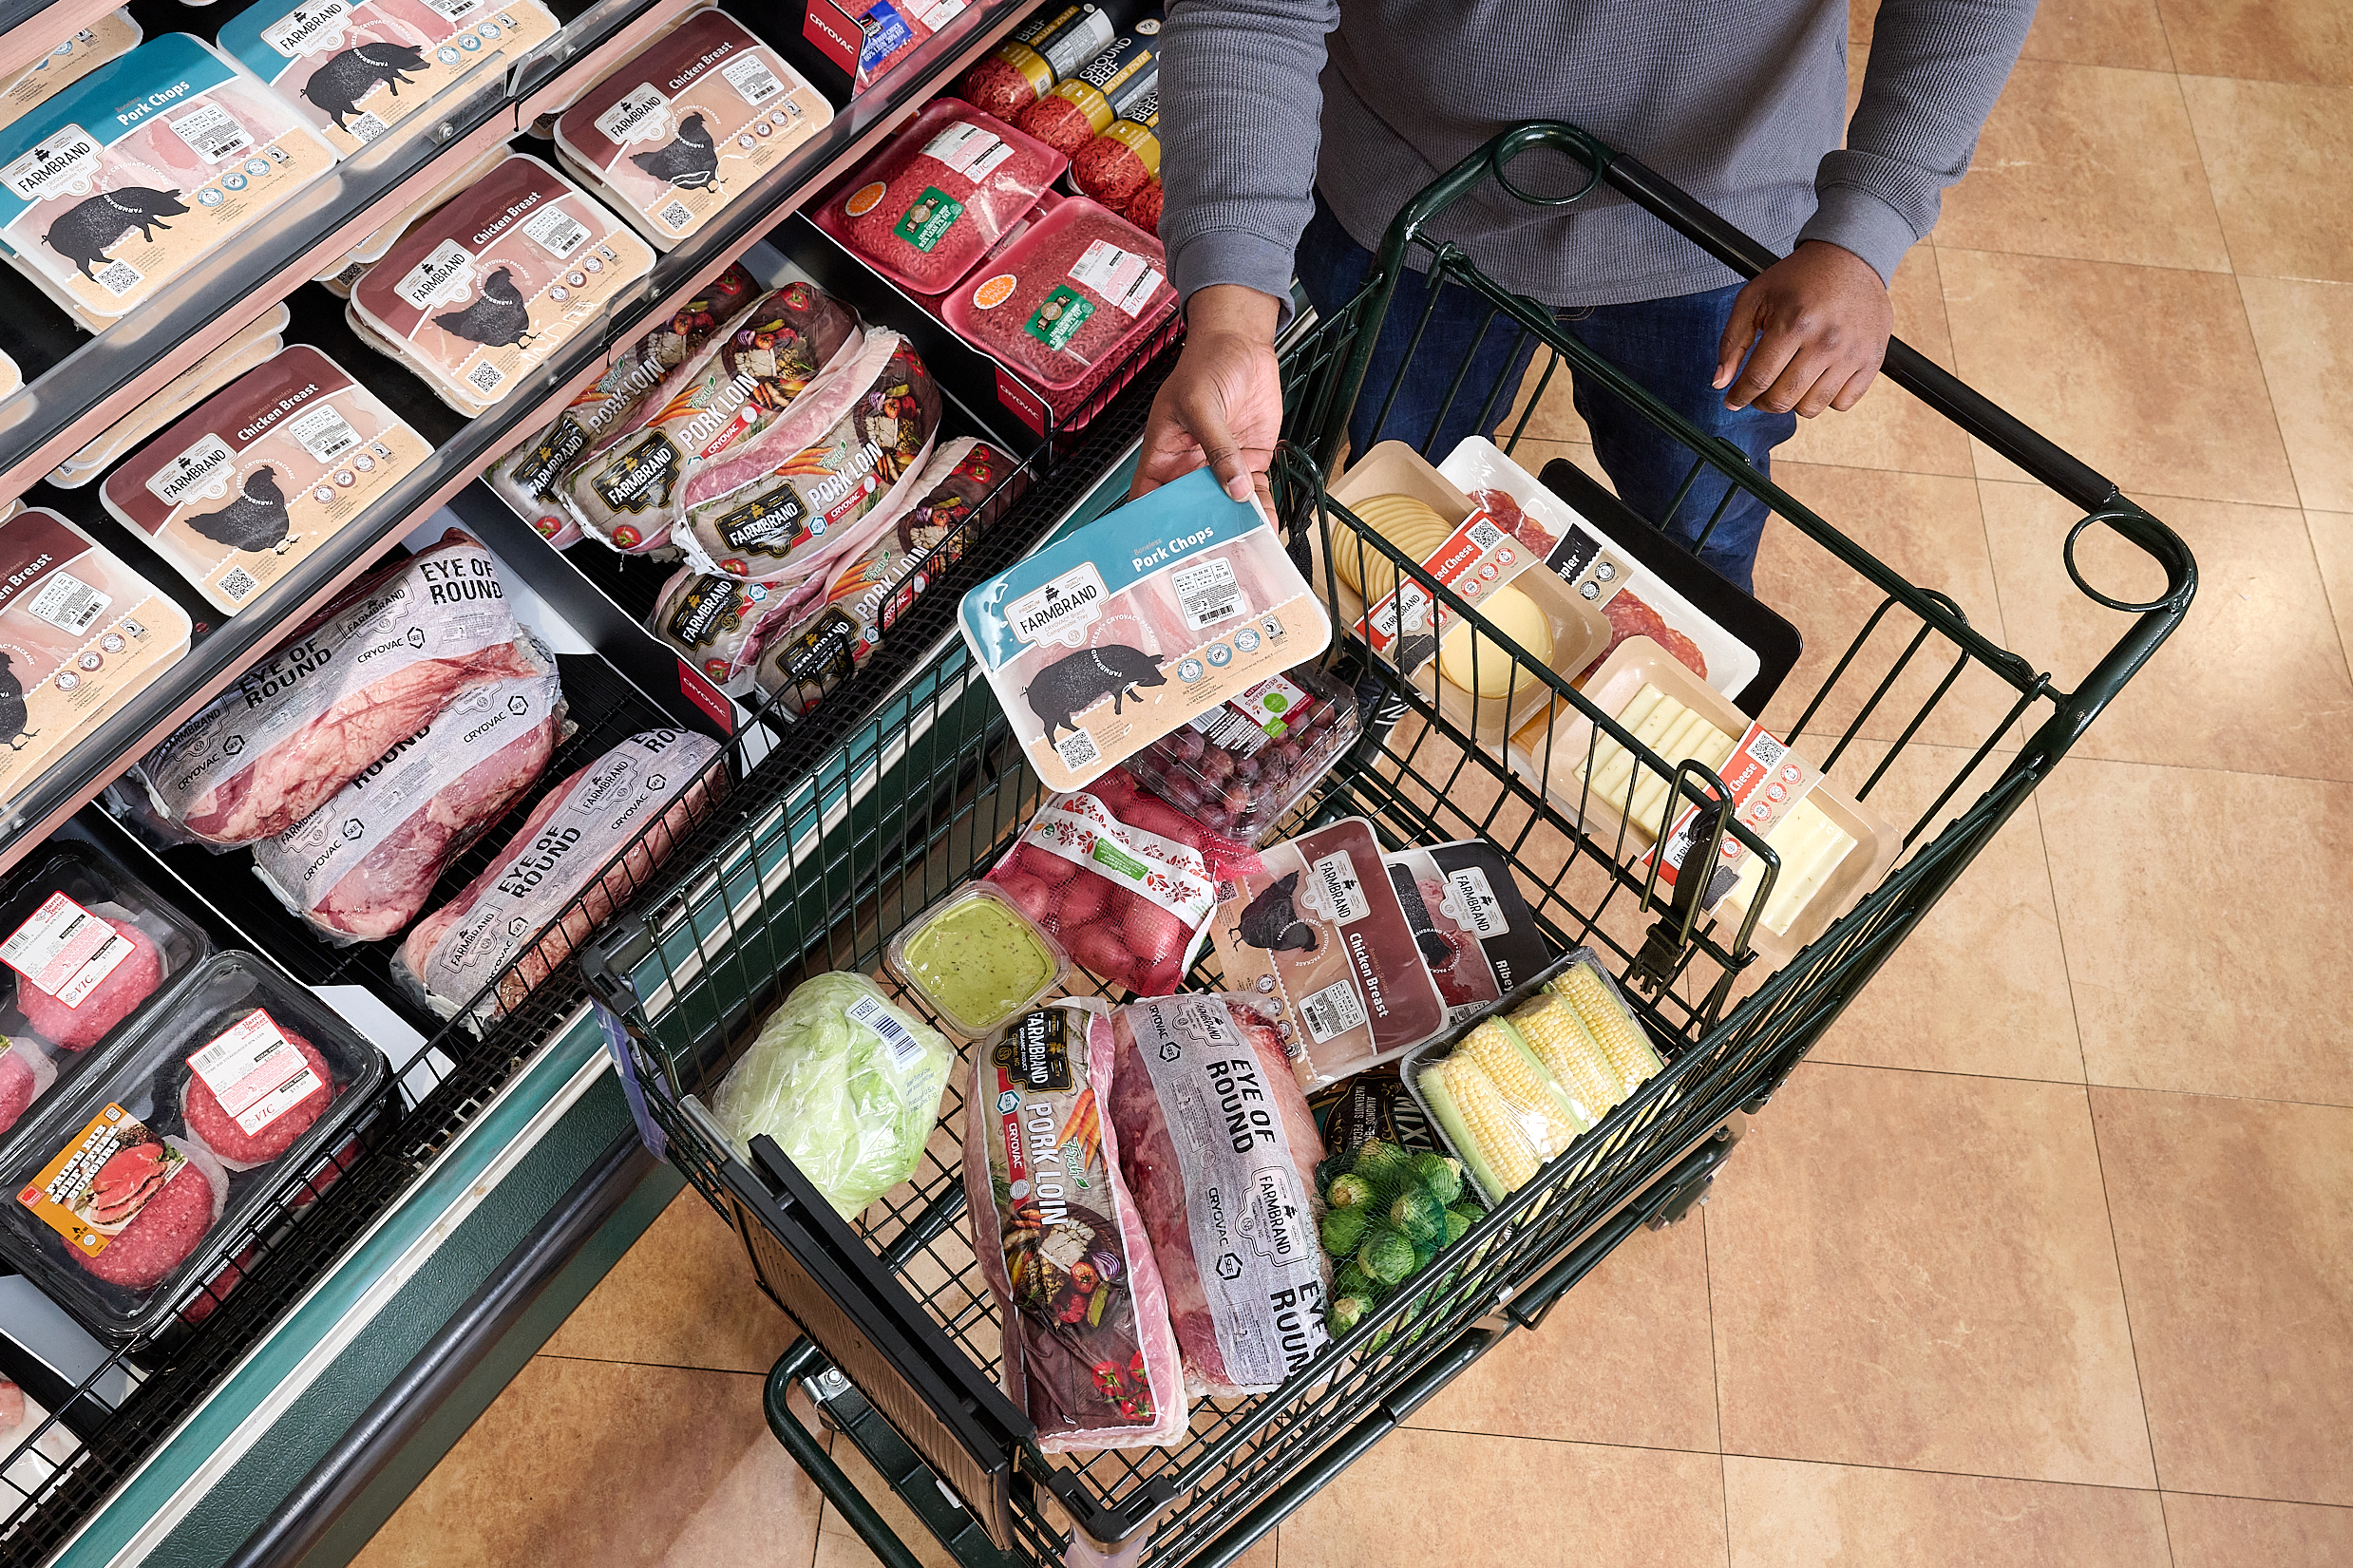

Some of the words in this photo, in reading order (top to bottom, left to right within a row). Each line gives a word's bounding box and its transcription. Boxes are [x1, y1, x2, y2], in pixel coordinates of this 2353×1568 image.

[279, 3, 342, 50] FARMBRAND
[809, 12, 854, 55] CRYOVAC
[876, 31, 891, 44] BEEF
[886, 22, 901, 36] CHUCK
[896, 28, 905, 38] FAT
[1015, 19, 1046, 42] BEEF
[1042, 25, 1055, 39] LEAN
[1066, 7, 1076, 18] FAT
[669, 60, 706, 90] Chicken
[702, 41, 733, 66] Breast
[1079, 37, 1132, 80] GROUND
[1091, 62, 1120, 87] BEEF
[1104, 80, 1116, 92] 73%
[1113, 69, 1129, 84] LEAN
[1128, 60, 1142, 72] 27%
[1139, 51, 1150, 63] FAT
[116, 102, 152, 126] Pork
[148, 80, 191, 106] Chops
[611, 96, 661, 137] FARMBRAND
[12, 161, 33, 177] PREMIUM
[53, 136, 72, 149] QUALITY
[17, 142, 90, 193] FARMBRAND
[852, 187, 876, 208] VALUE
[860, 192, 879, 209] PACK
[472, 212, 512, 245] Chicken
[508, 191, 541, 218] Breast
[919, 236, 930, 248] 93%
[927, 224, 939, 239] LEAN
[937, 217, 945, 229] 7%
[943, 210, 952, 220] FAT
[412, 254, 465, 302] FARMBRAND
[980, 279, 1005, 299] VALUE
[989, 284, 1009, 302] PACK
[1049, 333, 1061, 346] 93%
[1059, 323, 1072, 338] LEAN
[1074, 308, 1084, 319] FAT
[237, 408, 284, 443] Chicken
[280, 383, 319, 412] Breast
[248, 400, 273, 422] Boneless
[272, 387, 294, 406] Skinless
[587, 392, 631, 435] PORK
[629, 355, 667, 396] LOIN
[677, 406, 729, 451] PORK
[726, 371, 760, 413] LOIN
[686, 385, 714, 411] Fresh
[999, 383, 1039, 421] CRYOVAC
[708, 423, 739, 454] CRYOVAC
[163, 449, 227, 499] FARMBRAND
[527, 435, 583, 497] FARMBRAND
[607, 446, 673, 505] FARMBRAND
[806, 471, 856, 512] PORK
[854, 438, 884, 478] LOIN
[818, 446, 847, 471] Fresh
[630, 483, 650, 501] ORGANIC
[648, 467, 668, 486] PRODUCT
[729, 501, 799, 547] FARMBRAND
[830, 491, 861, 519] CRYOVAC
[1131, 546, 1170, 573] Pork
[1168, 526, 1214, 554] Chops
[1133, 538, 1163, 556] Boneless
[1445, 543, 1474, 570] Cheese
[12, 552, 53, 586] Breast
[420, 557, 466, 582] EYE
[470, 557, 493, 578] OF
[855, 576, 895, 620] PORK
[891, 545, 926, 584] LOIN
[347, 589, 406, 633] FARMBRAND
[429, 579, 503, 606] ROUND
[682, 580, 732, 643] FARMBRAND
[1018, 599, 1041, 614] PREMIUM
[1064, 576, 1085, 589] QUALITY
[1019, 584, 1097, 634] FARMBRAND
[411, 633, 421, 642] SEE
[1044, 615, 1071, 633] CRYOVAC®
[1070, 608, 1086, 619] Brand
[1046, 620, 1077, 637] Compostable
[1077, 614, 1089, 624] Tray
[1091, 626, 1103, 648] FRESH
[1140, 619, 1156, 648] PACKAGE
[238, 660, 285, 693] EYE
[289, 637, 321, 663] OF
[245, 648, 332, 709] ROUND
[1091, 650, 1123, 678] FARMBRAND
[682, 676, 728, 718] CRYOVAC
[1244, 689, 1267, 707] GRAPES
[1266, 677, 1278, 690] RED
[512, 701, 523, 709] SEE
[163, 708, 221, 751] FARMBRAND
[228, 740, 239, 750] SEE
[583, 761, 629, 809] FARMBRAND
[1729, 763, 1757, 792] Cheese
[348, 823, 359, 835] SEE
[497, 856, 537, 894] EYE
[535, 824, 563, 851] OF
[511, 827, 581, 898] ROUND
[43, 895, 62, 914] Harris
[48, 898, 66, 915] Teeter
[1319, 860, 1351, 918] FARMBRAND
[1455, 875, 1490, 932] FARMBRAND
[450, 913, 496, 967] FARMBRAND
[1277, 917, 1305, 941] FARMBRAND
[1305, 917, 1322, 929] FRESH
[1295, 954, 1321, 967] PACKAGE
[1349, 932, 1374, 979] Chicken
[1365, 975, 1390, 1019] Breast
[75, 974, 93, 994] VIC
[242, 1012, 263, 1029] Harris
[246, 1017, 266, 1032] Teeter
[1148, 1004, 1169, 1040] CRYOVAC
[1027, 1011, 1049, 1084] FARMBRAND
[1166, 1046, 1175, 1057] SEE
[255, 1104, 275, 1122] VIC
[1205, 1060, 1254, 1155] ROUND
[1231, 1059, 1262, 1102] EYE
[1252, 1105, 1277, 1144] OF
[1354, 1086, 1366, 1119] HAZELNUTS
[1365, 1096, 1376, 1125] ALMONDS
[1008, 1122, 1023, 1169] CRYOVAC
[1025, 1102, 1059, 1166] PORK
[1353, 1124, 1364, 1150] PECANS
[45, 1149, 86, 1196] PRIME
[82, 1124, 107, 1151] RIB
[49, 1168, 83, 1205] BEEF
[79, 1124, 120, 1169] STEAK
[66, 1139, 121, 1201] BURGERS
[1060, 1136, 1084, 1183] Fresh
[1034, 1171, 1070, 1226] LOIN
[1208, 1187, 1229, 1247] CRYOVAC
[1259, 1175, 1291, 1255] FARMBRAND
[1262, 1218, 1271, 1243] PRODUCT
[1292, 1224, 1300, 1246] QUALITY
[1224, 1258, 1234, 1274] SEE
